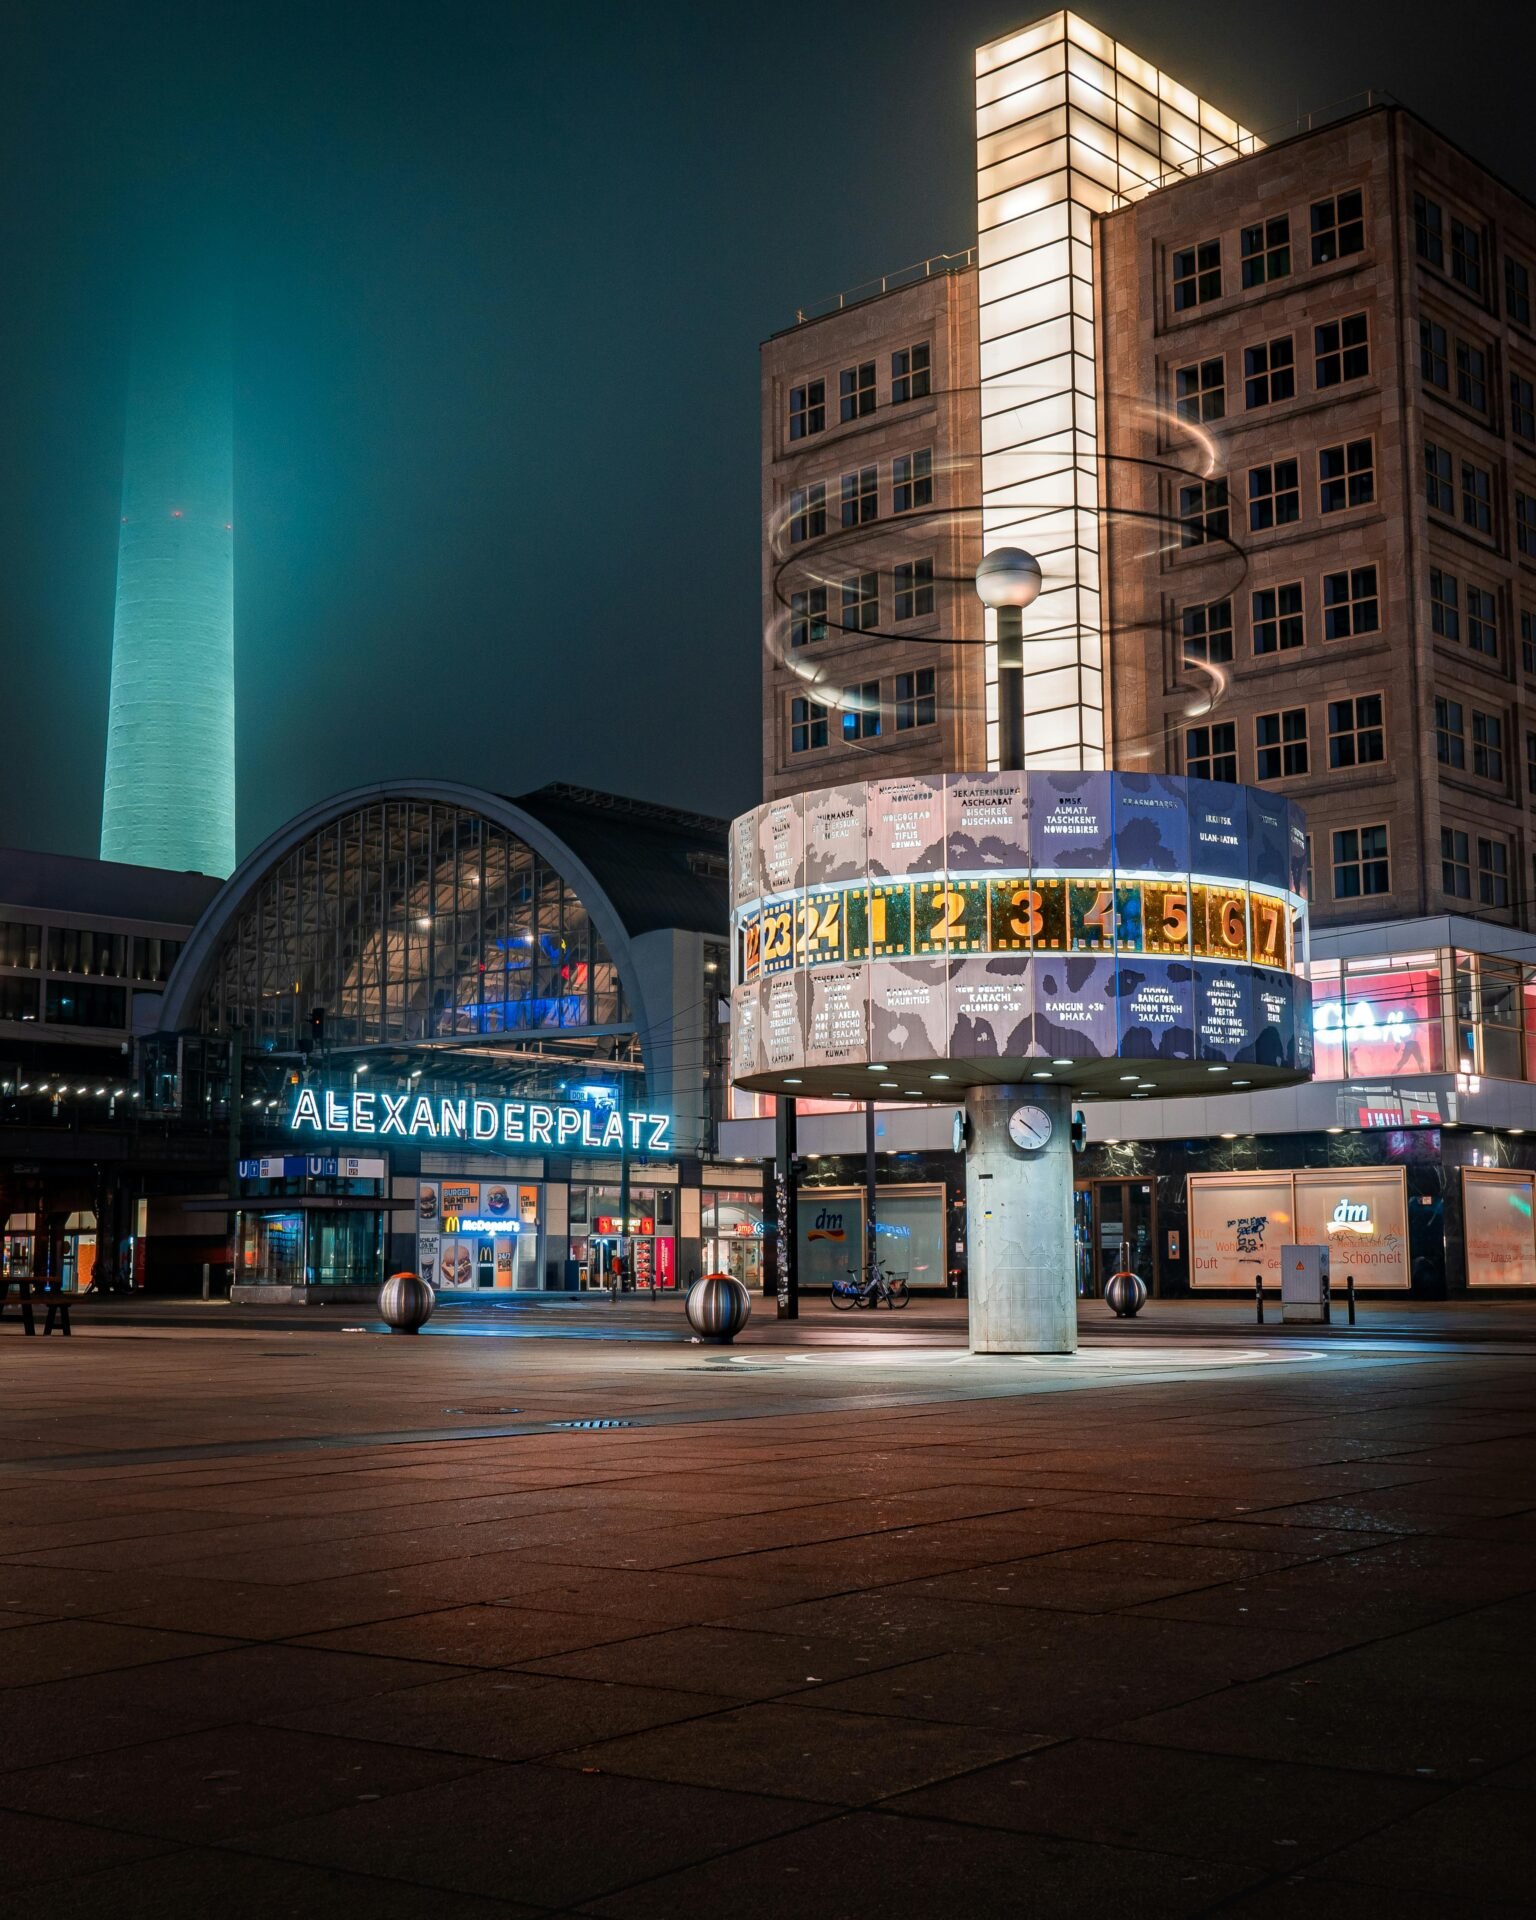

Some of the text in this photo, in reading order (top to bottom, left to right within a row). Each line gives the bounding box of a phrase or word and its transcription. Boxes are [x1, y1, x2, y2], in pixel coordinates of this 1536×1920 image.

[892, 792, 932, 802] NOWGOROD
[953, 788, 1020, 798] JEKATERINBURG
[961, 798, 1012, 806] ASCHGABAT
[1054, 806, 1088, 814] ALMATY
[882, 811, 930, 822] WOLGOGRAD
[961, 816, 1013, 826] DUSCHANBE
[1046, 816, 1096, 824] TASCHKENT
[896, 822, 916, 830] BAKU
[1044, 826, 1099, 834] NOWOSIBIRSK
[894, 831, 918, 840] TIFLIS
[892, 840, 922, 848] ERIWAN
[930, 892, 966, 938] 2
[1010, 890, 1044, 937] 3
[1083, 892, 1122, 936] 4
[1162, 894, 1190, 942] 5
[864, 898, 886, 943] 1
[1221, 900, 1245, 948] 6
[796, 903, 840, 952] 24
[1262, 906, 1279, 953] 7
[762, 912, 792, 961] 23
[955, 984, 974, 992] NEW
[888, 996, 930, 1006] MAURITIUS
[1138, 994, 1174, 1004] BANGKOK
[1212, 998, 1238, 1008] MANILA
[824, 1002, 850, 1010] SANAA
[960, 1003, 999, 1012] COLOMBO
[1045, 1003, 1083, 1011] RANGUN
[1130, 1004, 1182, 1014] PHNOM PENH
[815, 1010, 860, 1021] ADDS ABEBA
[1060, 1012, 1092, 1020] DHAKA
[1214, 1008, 1234, 1016] PERTH
[1138, 1014, 1175, 1022] JAKARTA
[1208, 1016, 1242, 1026] HONGKONG
[1201, 1026, 1222, 1034] KUALA
[826, 1049, 850, 1057] KUWAIT
[290, 1088, 670, 1150] ALEXANDERPLATZ
[240, 1161, 248, 1177] U
[310, 1158, 322, 1174] U
[1334, 1199, 1368, 1222] dm
[816, 1208, 842, 1230] dm
[1342, 1251, 1402, 1264] Schönheit
[498, 1259, 511, 1268] FÜR
[1196, 1257, 1218, 1269] Duft
